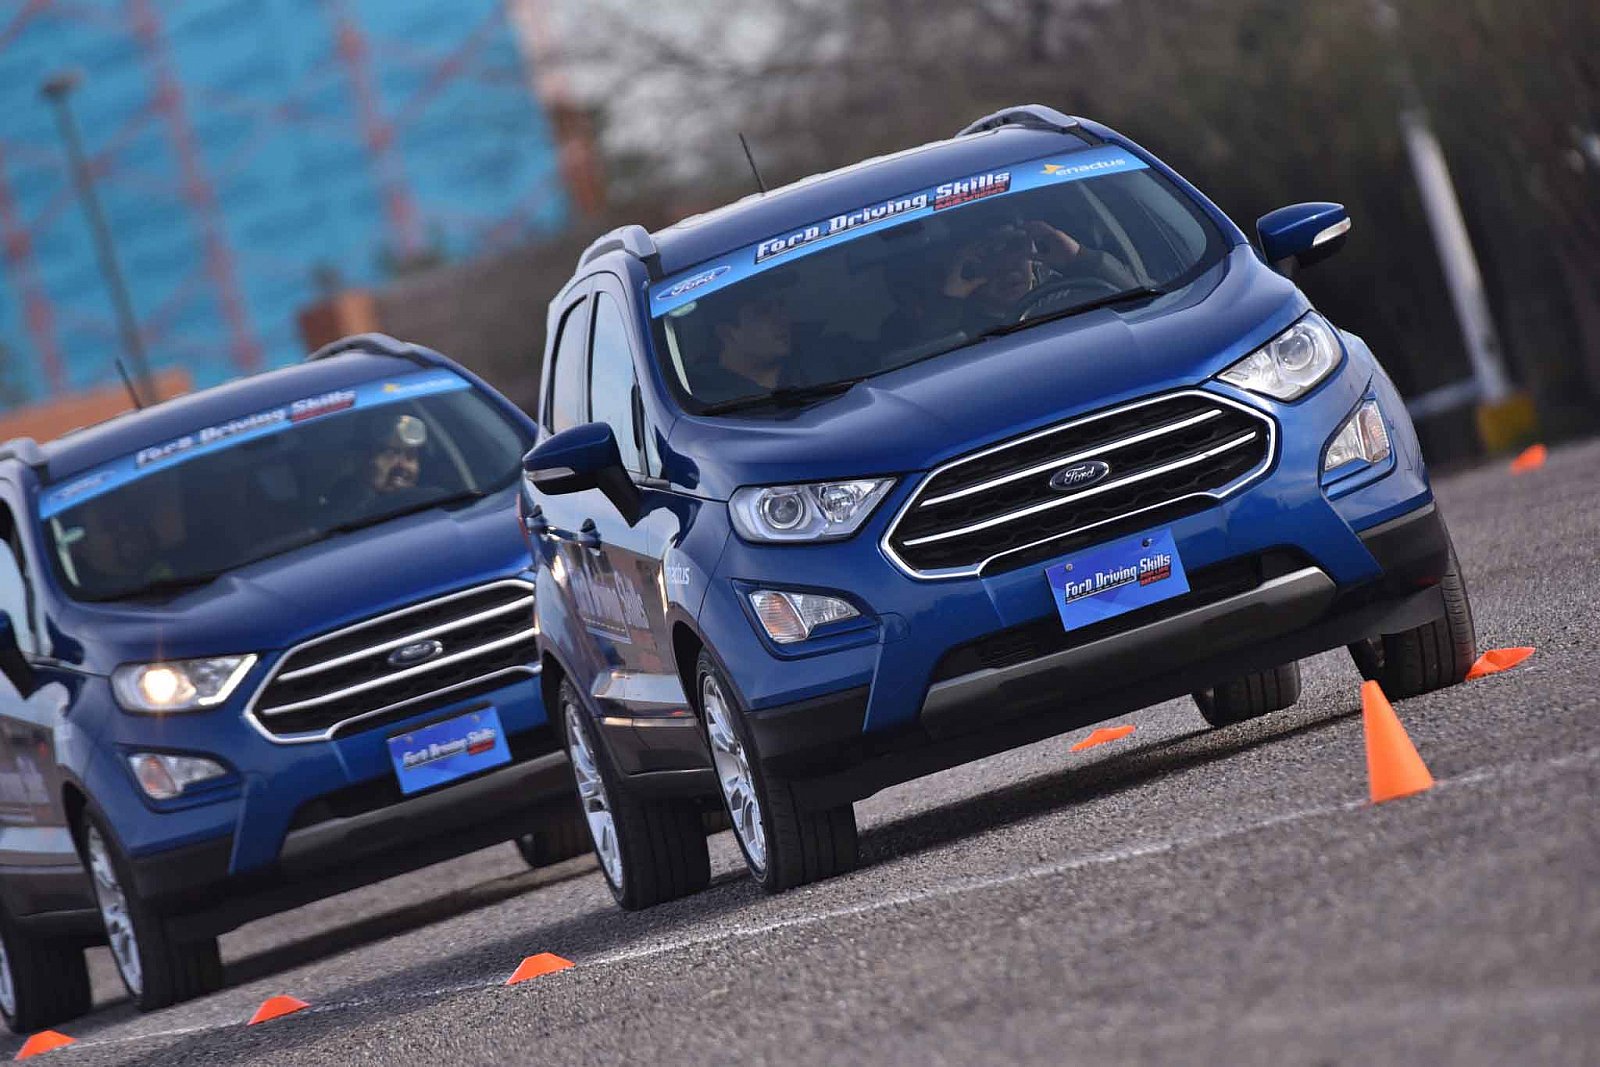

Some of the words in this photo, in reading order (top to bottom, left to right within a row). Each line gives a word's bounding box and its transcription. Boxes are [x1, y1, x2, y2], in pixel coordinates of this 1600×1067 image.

[1055, 158, 1127, 177] enactus
[828, 192, 928, 232] Driving
[935, 172, 1011, 199] Skills
[670, 268, 717, 297] Ford
[1064, 465, 1096, 484] Ford
[1095, 565, 1138, 588] Driving
[1140, 554, 1171, 573] Skills
